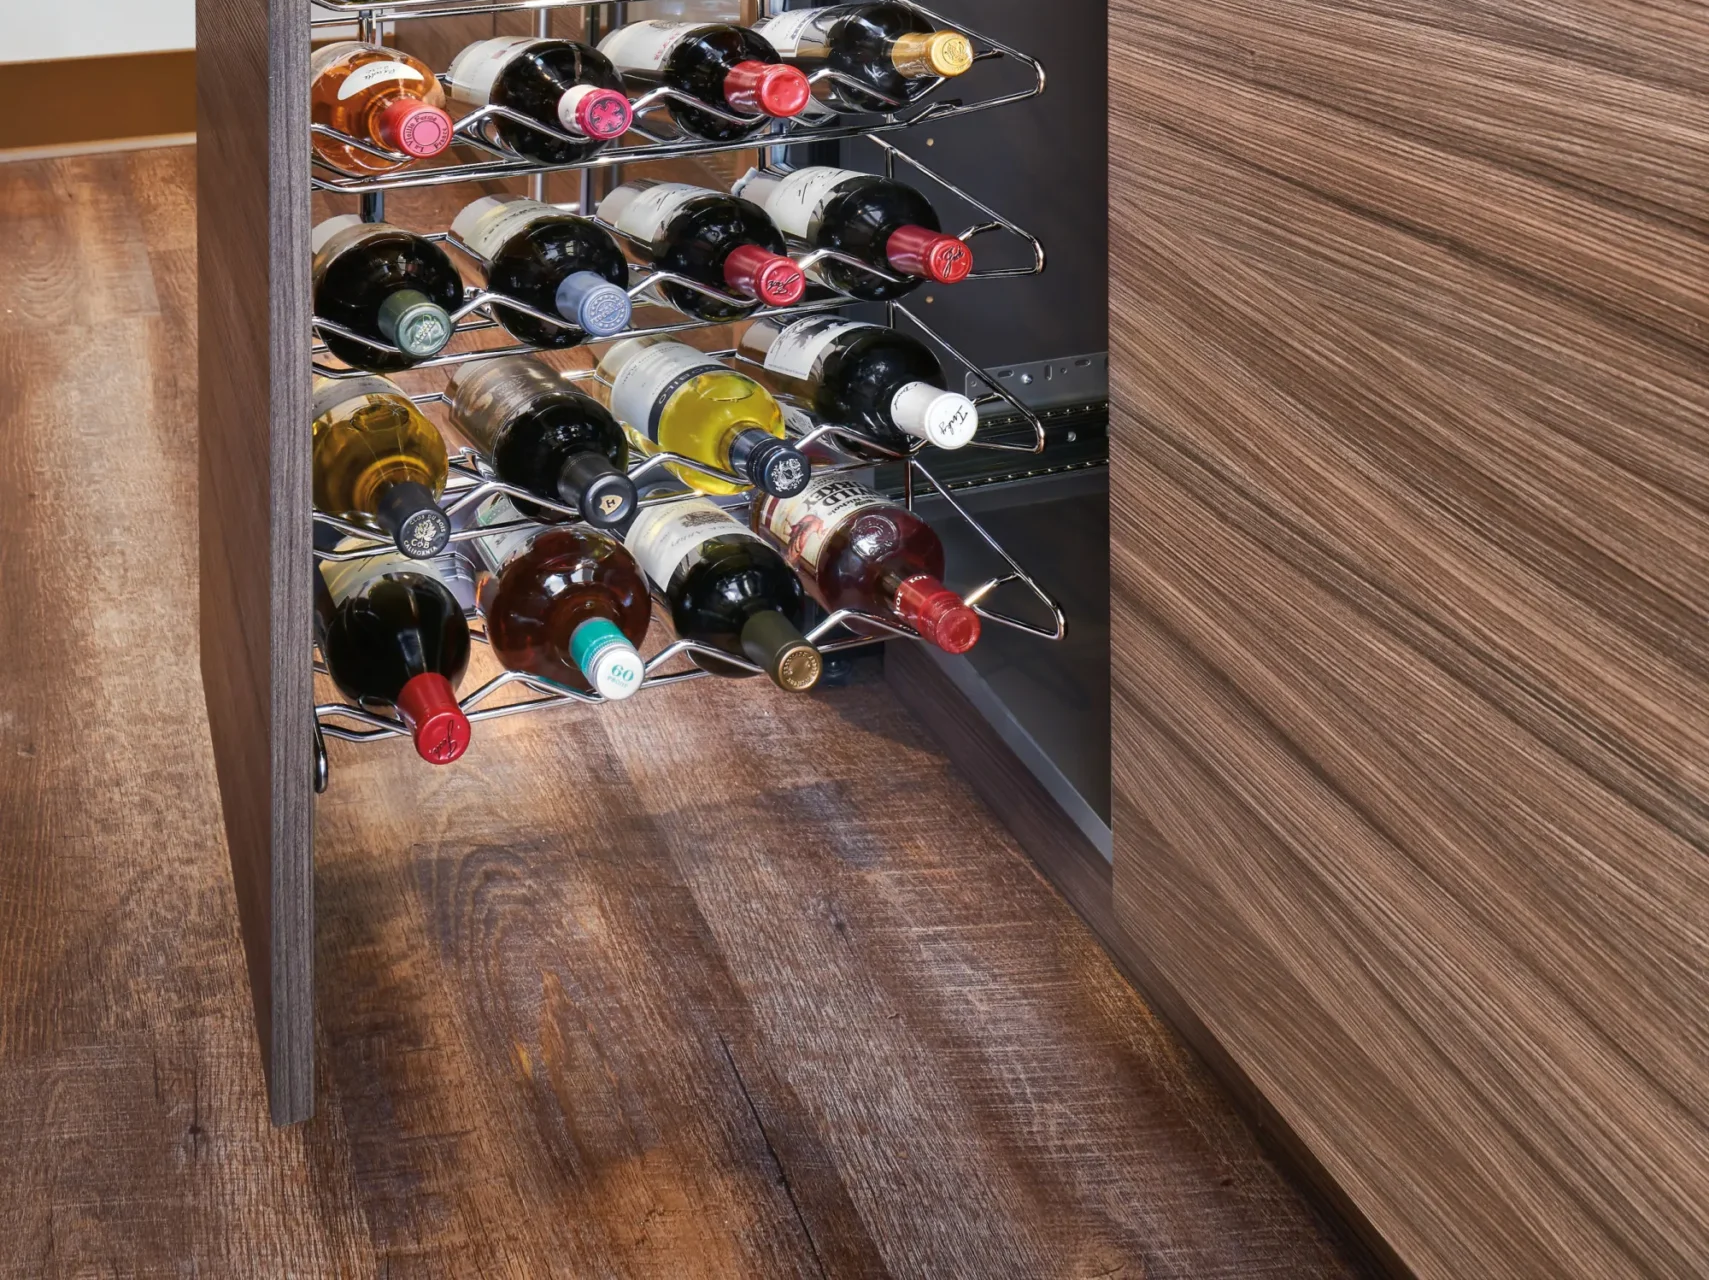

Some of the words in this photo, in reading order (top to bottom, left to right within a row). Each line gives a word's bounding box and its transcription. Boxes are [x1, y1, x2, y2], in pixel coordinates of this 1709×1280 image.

[405, 123, 415, 147] Vieille
[605, 499, 615, 508] H
[410, 515, 425, 525] CLOS
[436, 519, 446, 532] BOIS
[403, 540, 438, 556] CALIFORNIA
[611, 665, 634, 682] 60
